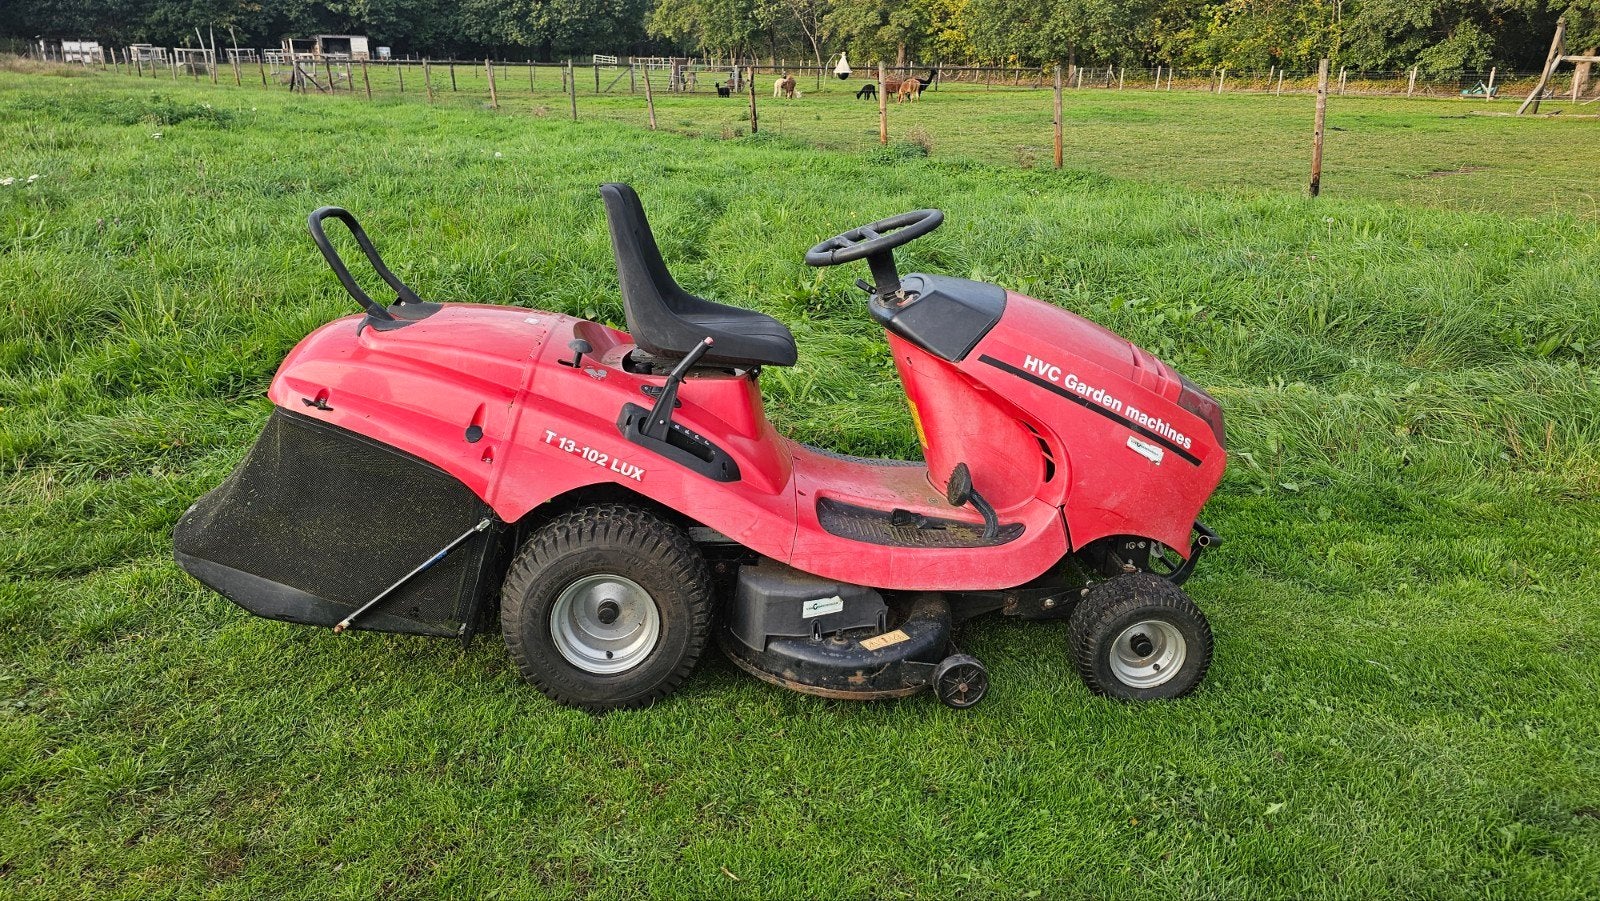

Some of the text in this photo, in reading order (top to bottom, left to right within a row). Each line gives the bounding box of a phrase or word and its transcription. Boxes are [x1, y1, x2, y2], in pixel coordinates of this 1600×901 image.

[1023, 354, 1062, 382] HVC
[1064, 373, 1123, 412] Garden
[1125, 405, 1192, 450] machines
[544, 429, 646, 482] T 13-102 LUX
